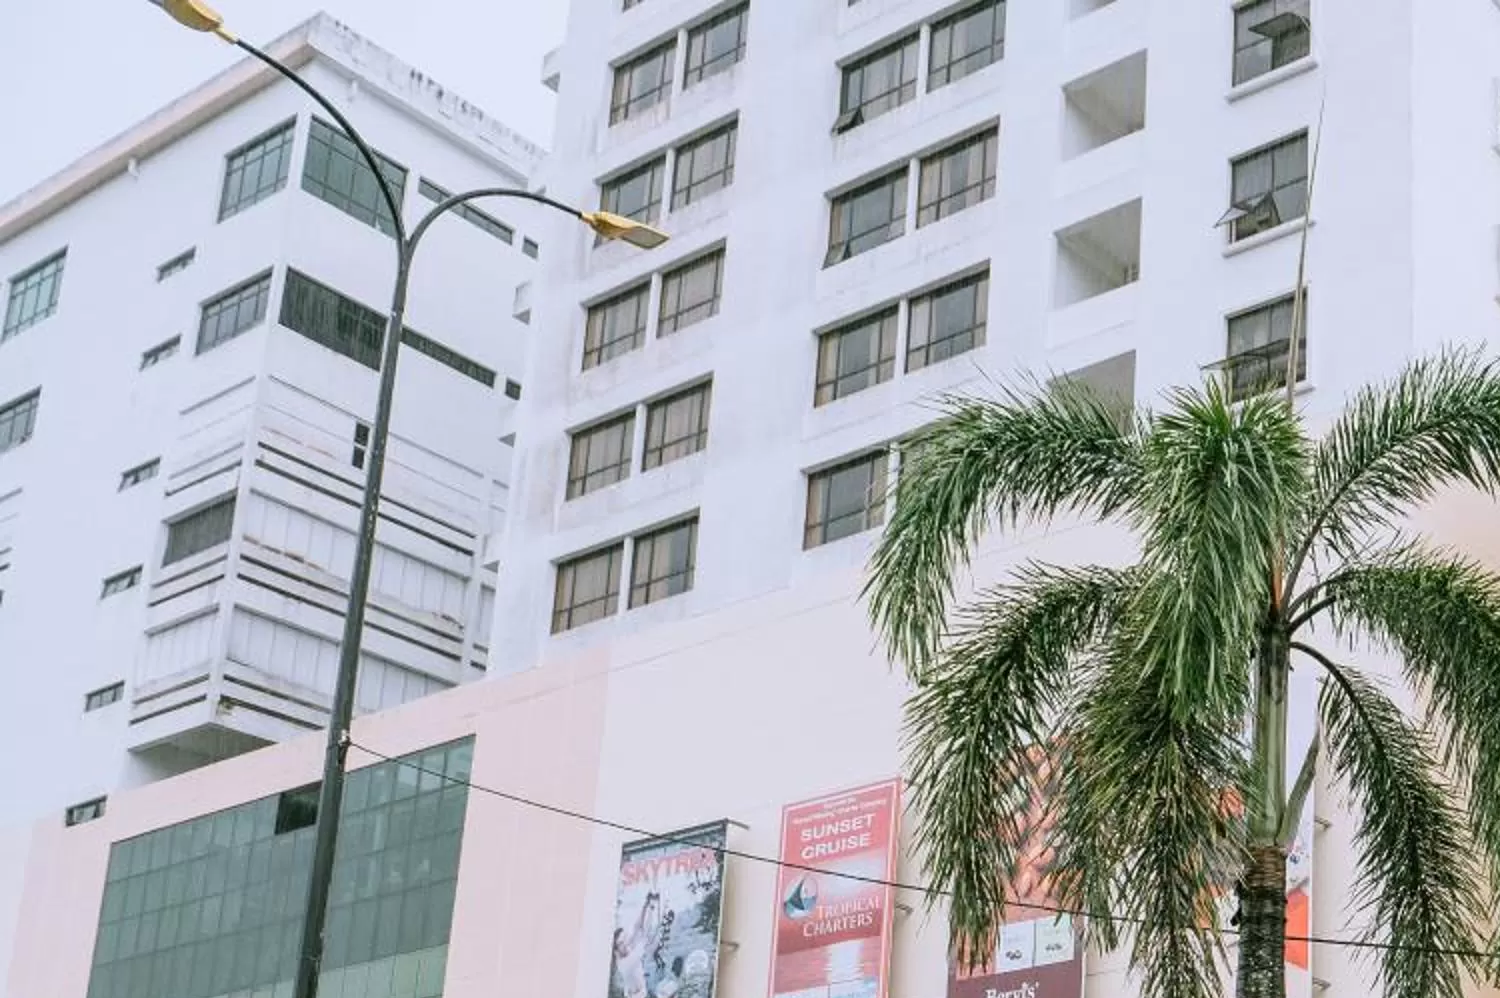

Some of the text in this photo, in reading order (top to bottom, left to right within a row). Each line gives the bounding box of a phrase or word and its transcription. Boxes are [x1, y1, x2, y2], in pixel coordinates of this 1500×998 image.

[800, 813, 876, 842] SUNSET
[801, 833, 872, 861] CRUISE
[803, 911, 873, 938] CHARTERS
